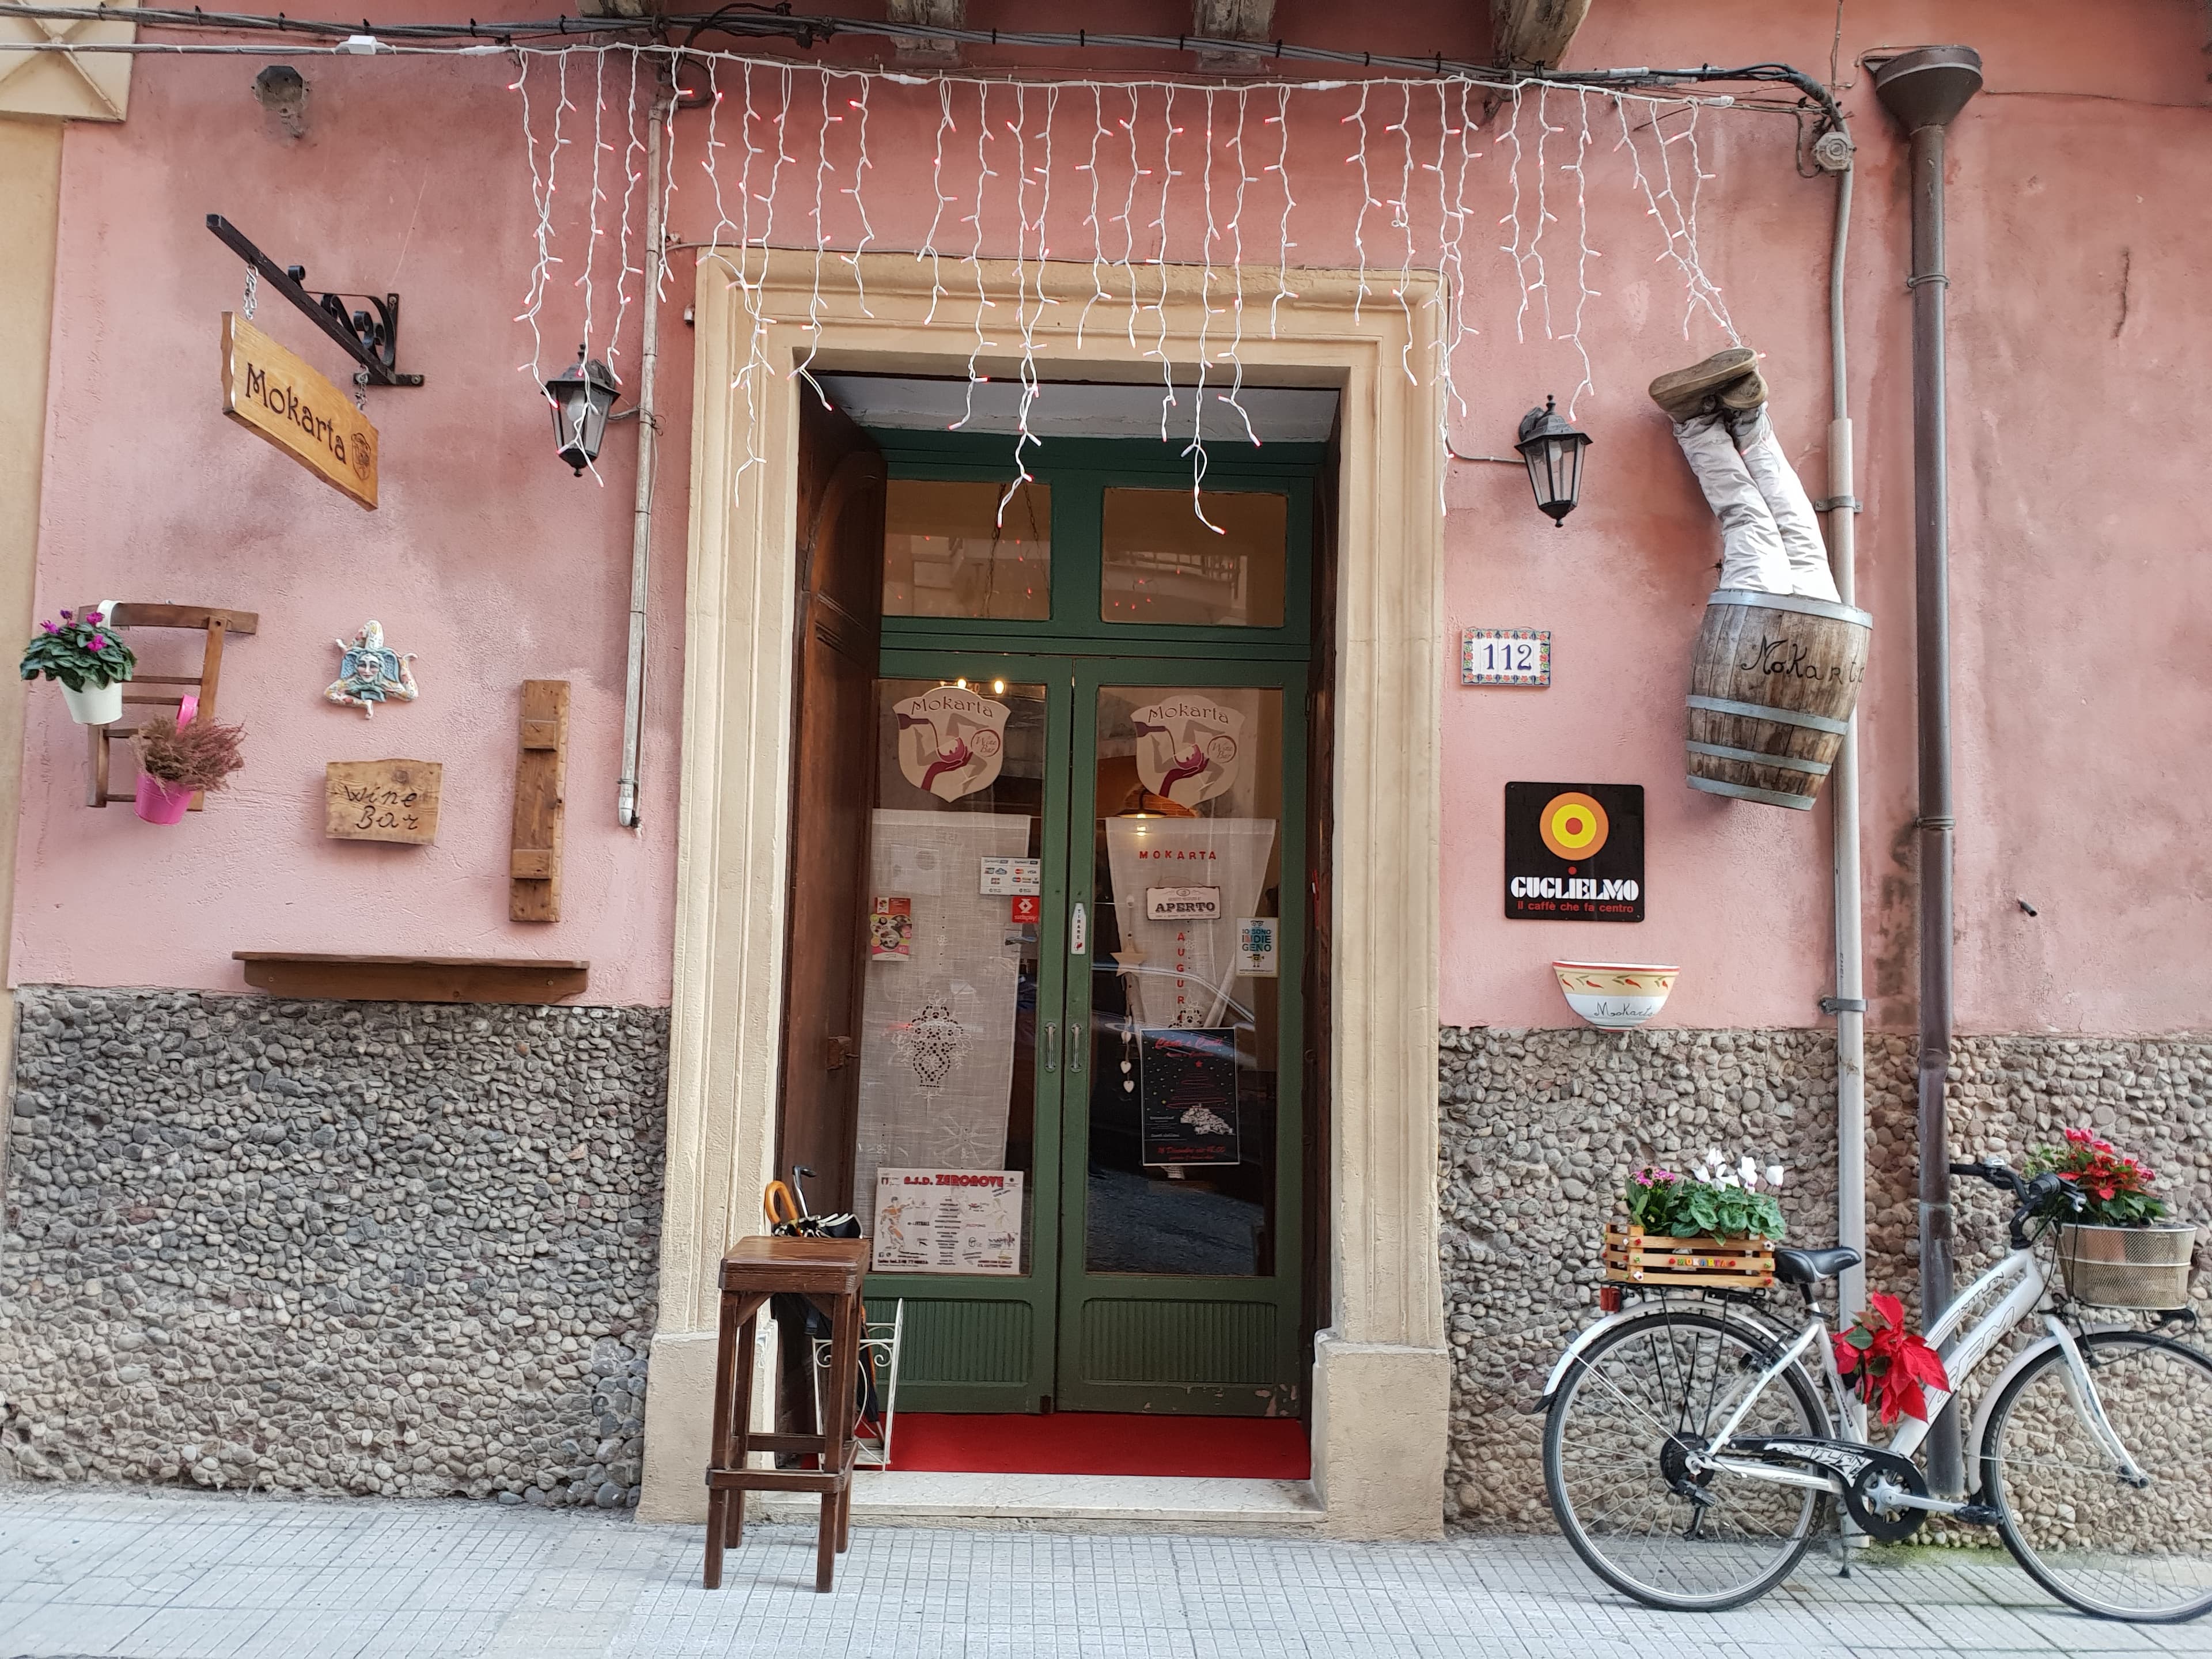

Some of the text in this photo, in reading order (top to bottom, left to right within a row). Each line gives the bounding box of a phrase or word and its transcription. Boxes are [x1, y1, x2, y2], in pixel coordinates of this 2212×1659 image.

[245, 362, 346, 464] Mokarta
[1483, 643, 1532, 670] 112
[911, 696, 993, 718] Mokarta
[1148, 703, 1229, 724] Mokarta
[354, 805, 418, 830] Bar
[1139, 850, 1217, 860] MOKARTA
[1510, 876, 1639, 902] GUGLIELMO
[1155, 902, 1215, 913] APERTO
[1517, 900, 1634, 913] il caffè che fa centro
[1242, 935, 1272, 944] INDIE
[1242, 944, 1272, 952] GENO
[1677, 1257, 1727, 1268] MOKARTA
[1960, 1271, 2004, 1312] SATURN
